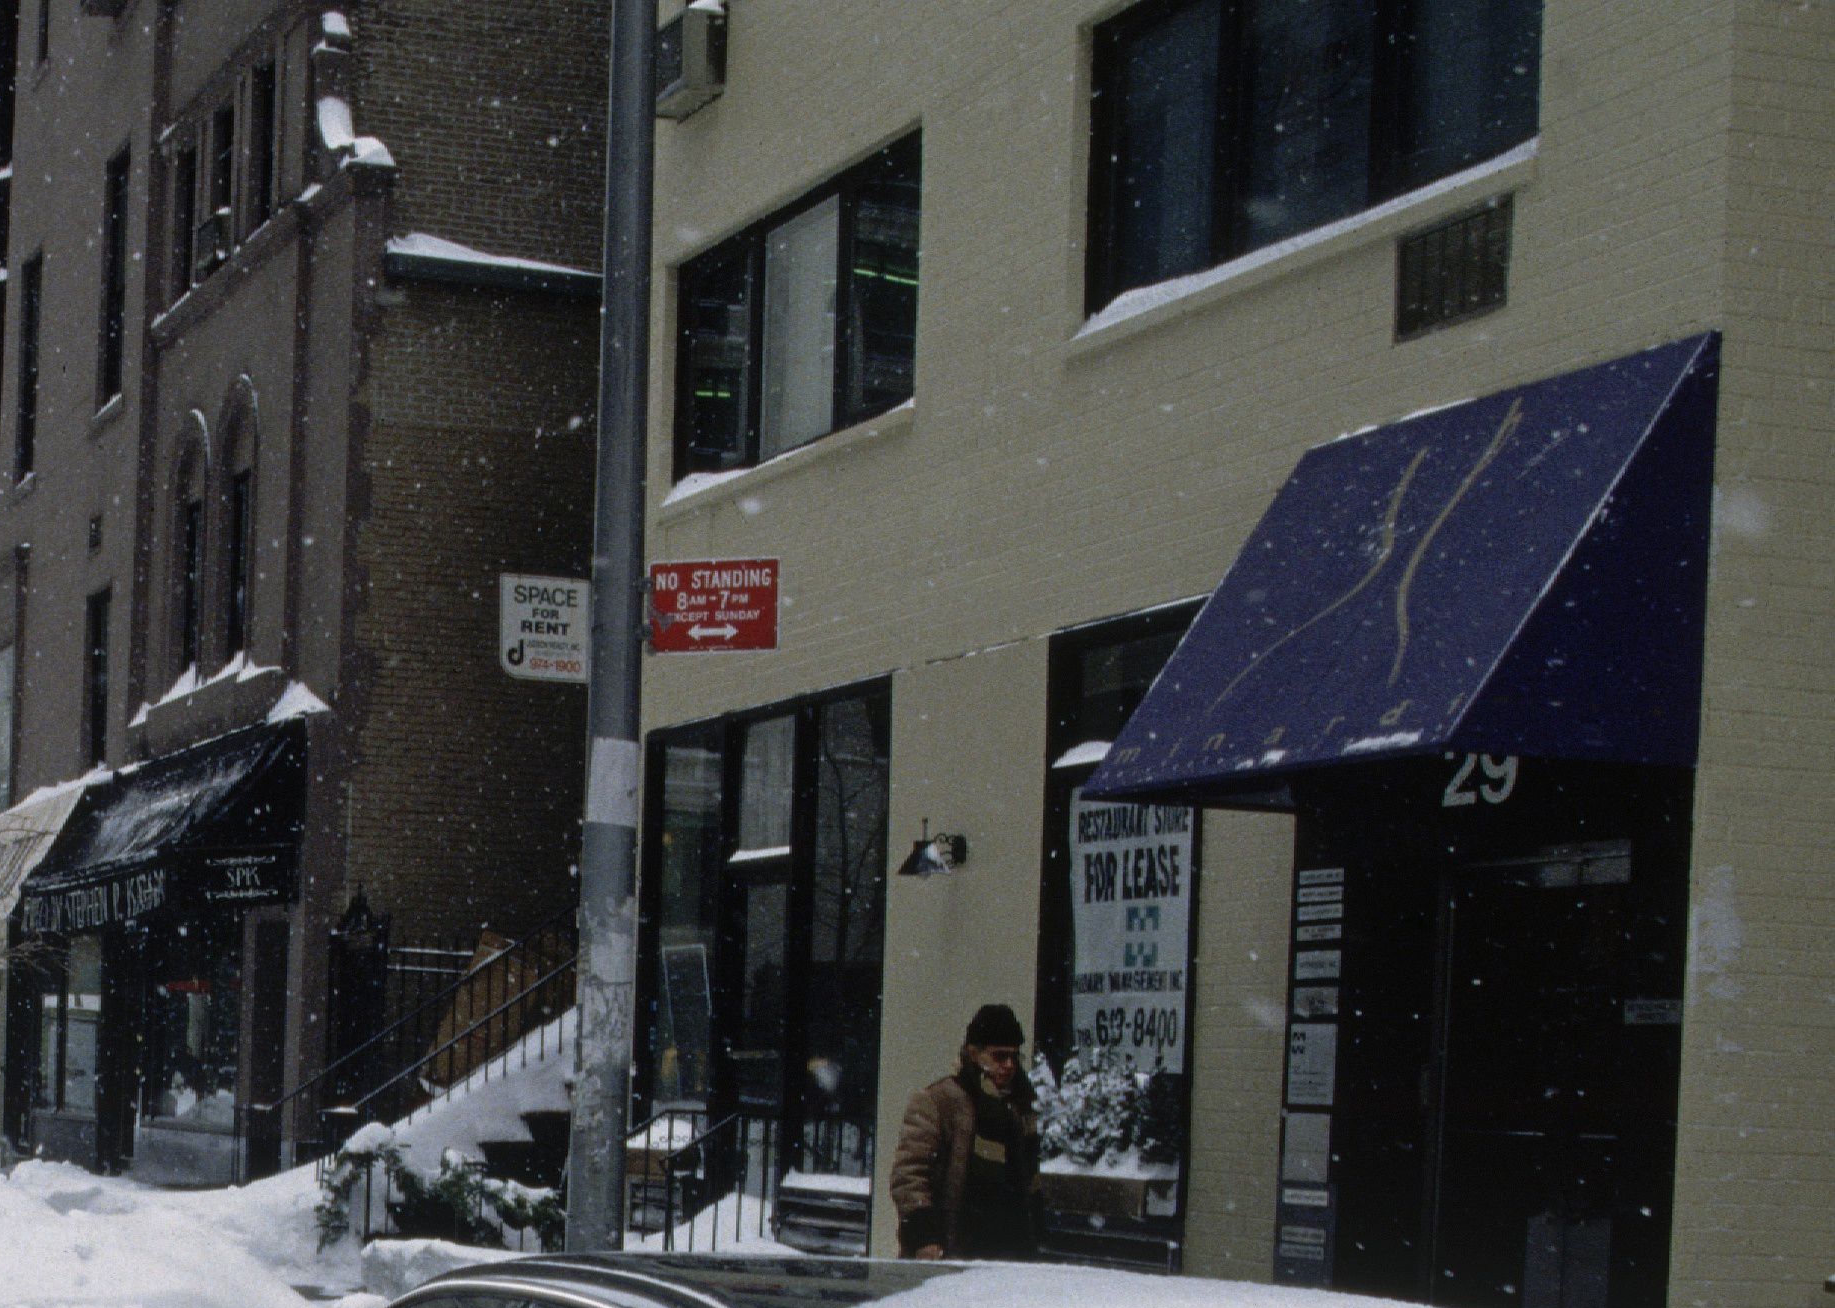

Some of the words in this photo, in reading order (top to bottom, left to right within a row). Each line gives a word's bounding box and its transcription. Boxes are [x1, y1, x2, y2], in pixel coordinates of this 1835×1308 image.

[656, 571, 678, 591] NO
[692, 568, 772, 590] STANDING
[514, 584, 578, 607] SPACE
[532, 607, 560, 619] FOR
[715, 609, 760, 621] SUNDAY
[520, 619, 571, 636] RENT
[1442, 751, 1517, 807] 29
[1083, 850, 1117, 903] FOR
[1122, 843, 1179, 899] LEASE
